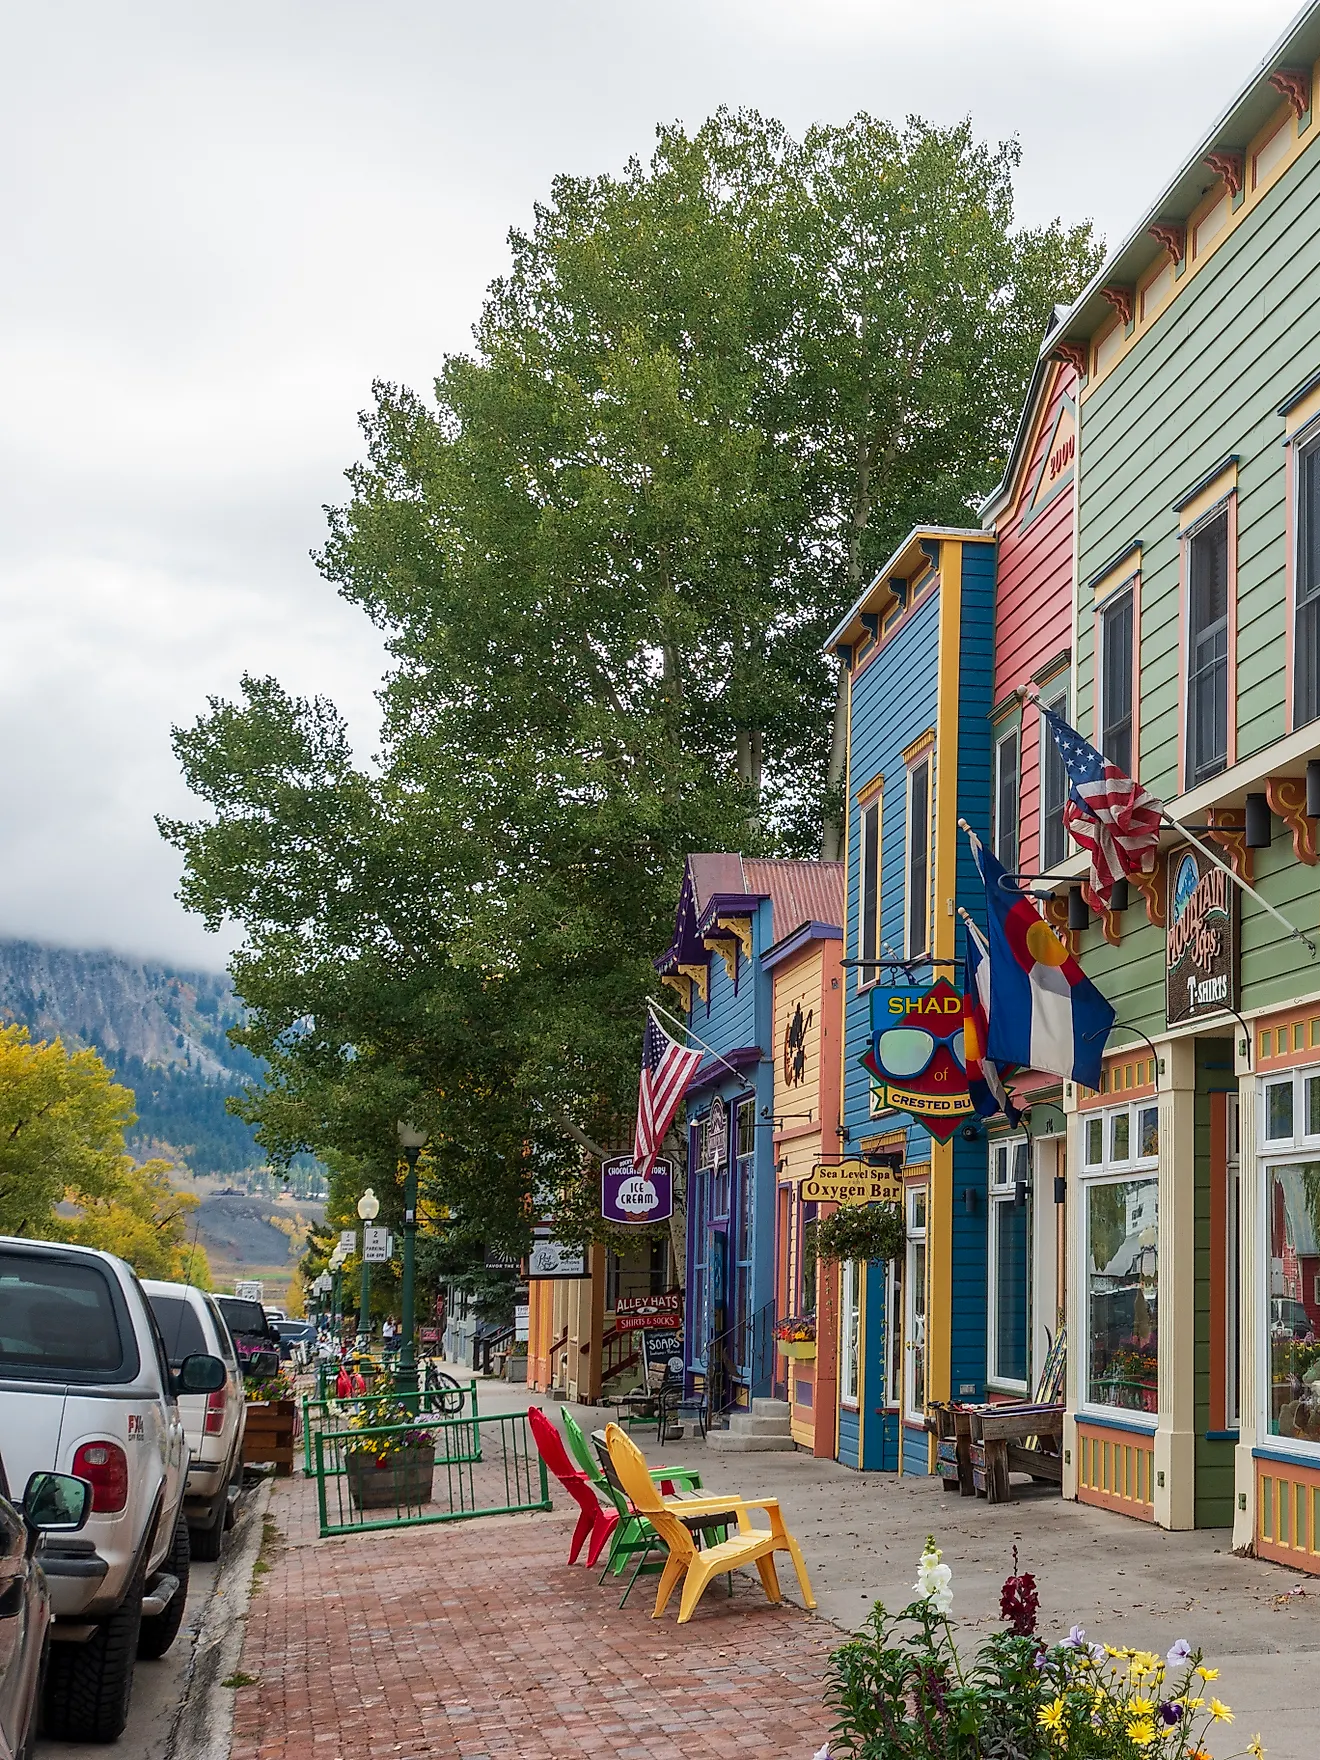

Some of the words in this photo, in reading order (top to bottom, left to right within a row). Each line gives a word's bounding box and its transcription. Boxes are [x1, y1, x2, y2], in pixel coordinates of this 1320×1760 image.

[1167, 868, 1229, 968] MOUNTAIN
[1187, 975, 1228, 1013] T-SHIRTS
[889, 997, 963, 1015] SHAD
[934, 1067, 949, 1082] of
[892, 1094, 950, 1110] CRESTED
[954, 1099, 971, 1110] BU
[820, 1169, 838, 1179] Sea
[841, 1170, 868, 1179] Level
[870, 1169, 890, 1181] Spa
[630, 1182, 644, 1193] ICE
[807, 1182, 865, 1200] Oxygen
[870, 1183, 900, 1198] Bar
[621, 1194, 653, 1204] CREAM
[373, 1230, 379, 1238] 2
[616, 1297, 649, 1313] ALLEY
[651, 1296, 678, 1309] HATS
[621, 1317, 645, 1329] SHIRTS
[653, 1316, 675, 1326] SOCKS
[649, 1338, 680, 1350] SOAPS
